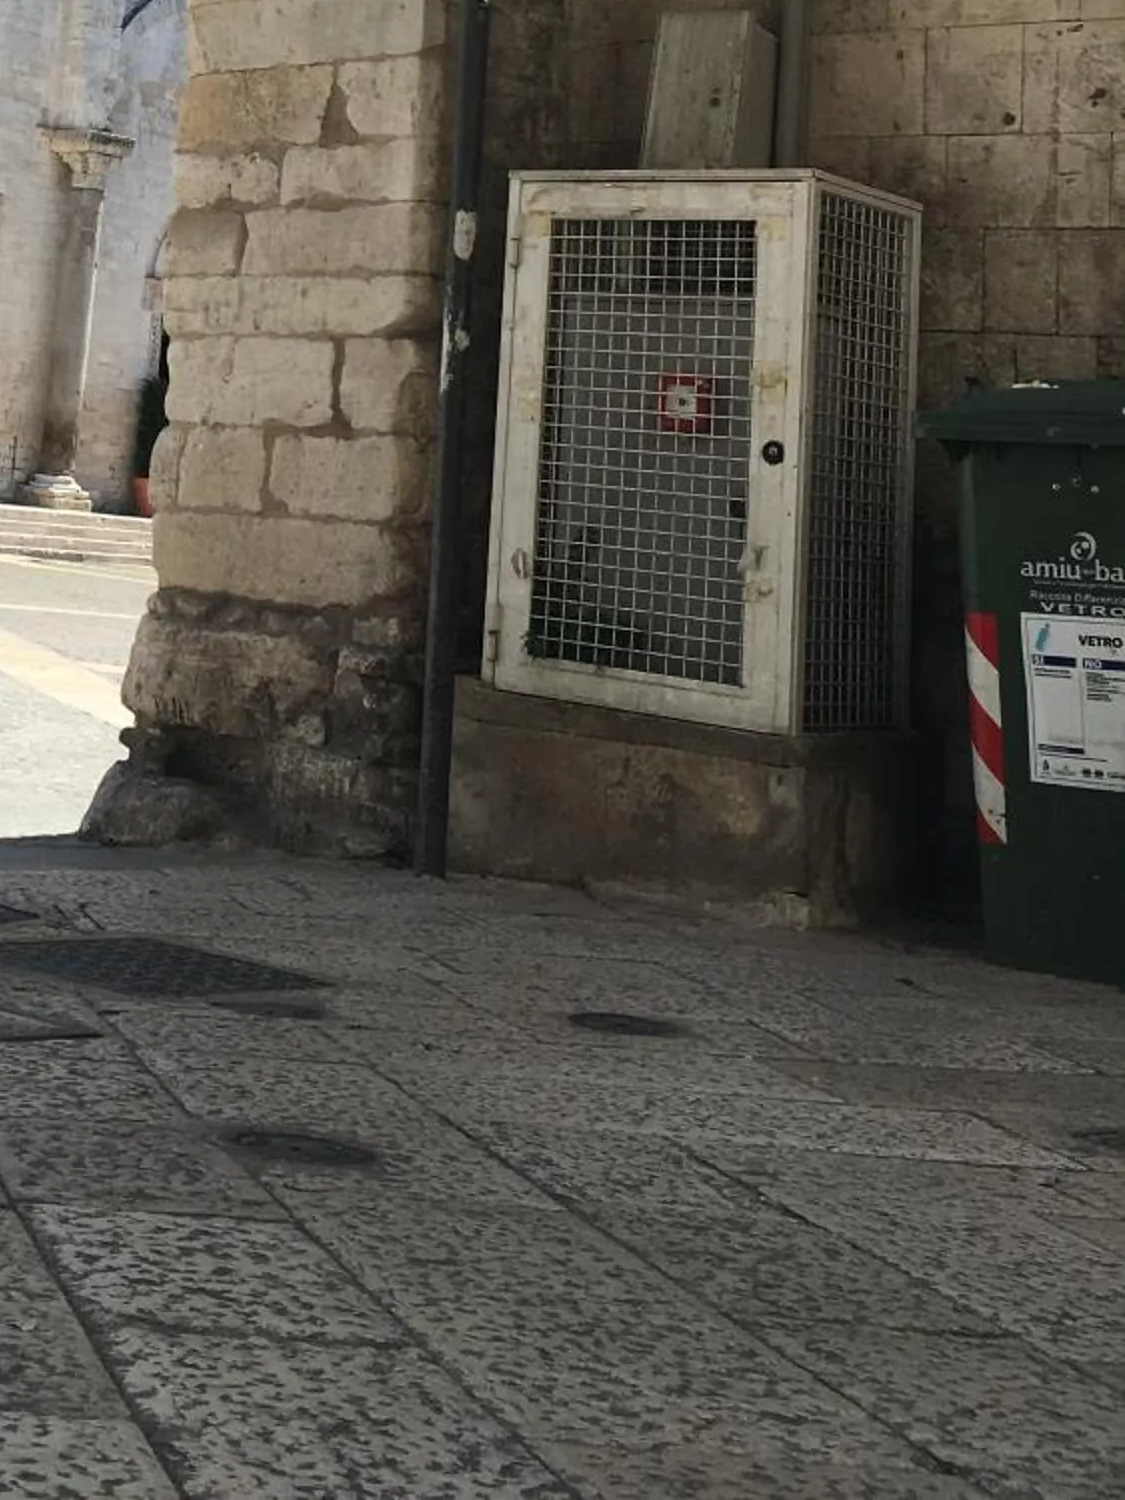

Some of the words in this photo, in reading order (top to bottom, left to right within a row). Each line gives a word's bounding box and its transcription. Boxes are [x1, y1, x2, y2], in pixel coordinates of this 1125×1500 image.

[1020, 556, 1082, 580] amiu
[1040, 601, 1125, 618] VETRO
[1078, 635, 1124, 649] VETRO
